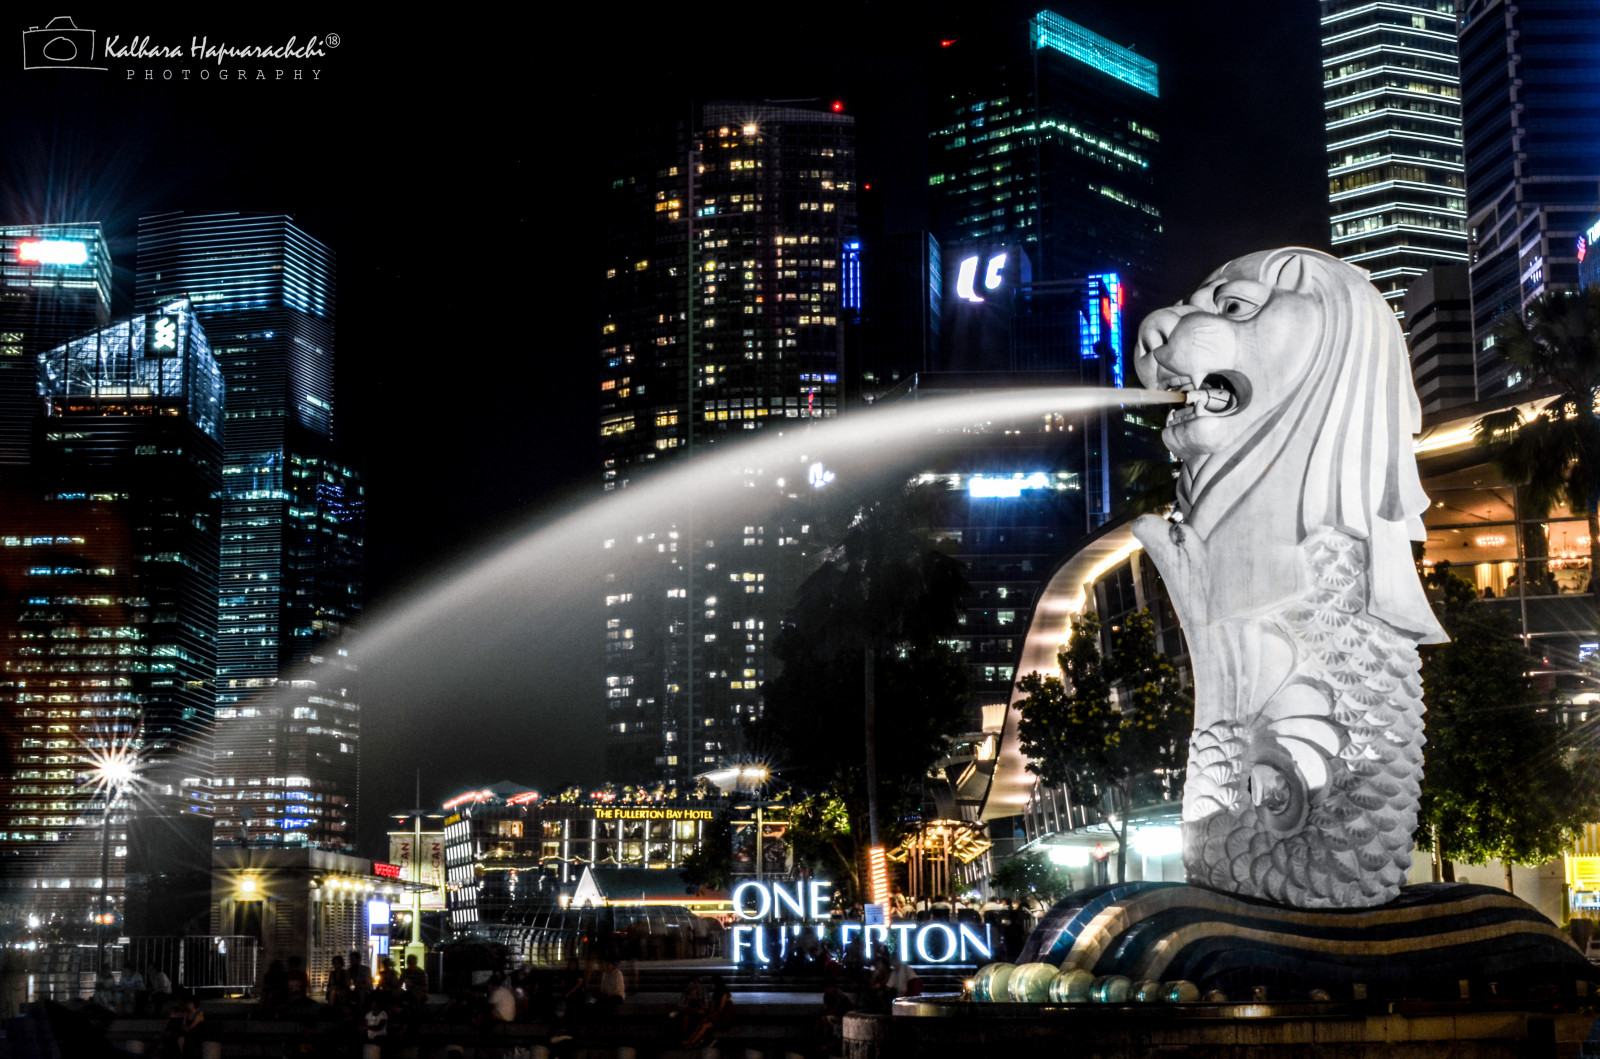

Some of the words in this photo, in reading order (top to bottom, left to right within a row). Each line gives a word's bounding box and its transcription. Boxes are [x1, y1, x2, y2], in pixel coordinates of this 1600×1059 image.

[595, 809, 613, 819] THE
[614, 809, 665, 819] FULLERTON
[666, 810, 683, 819] BAY
[684, 810, 714, 820] HOTEL
[732, 880, 832, 920] ONE
[732, 922, 992, 964] FUERTON
